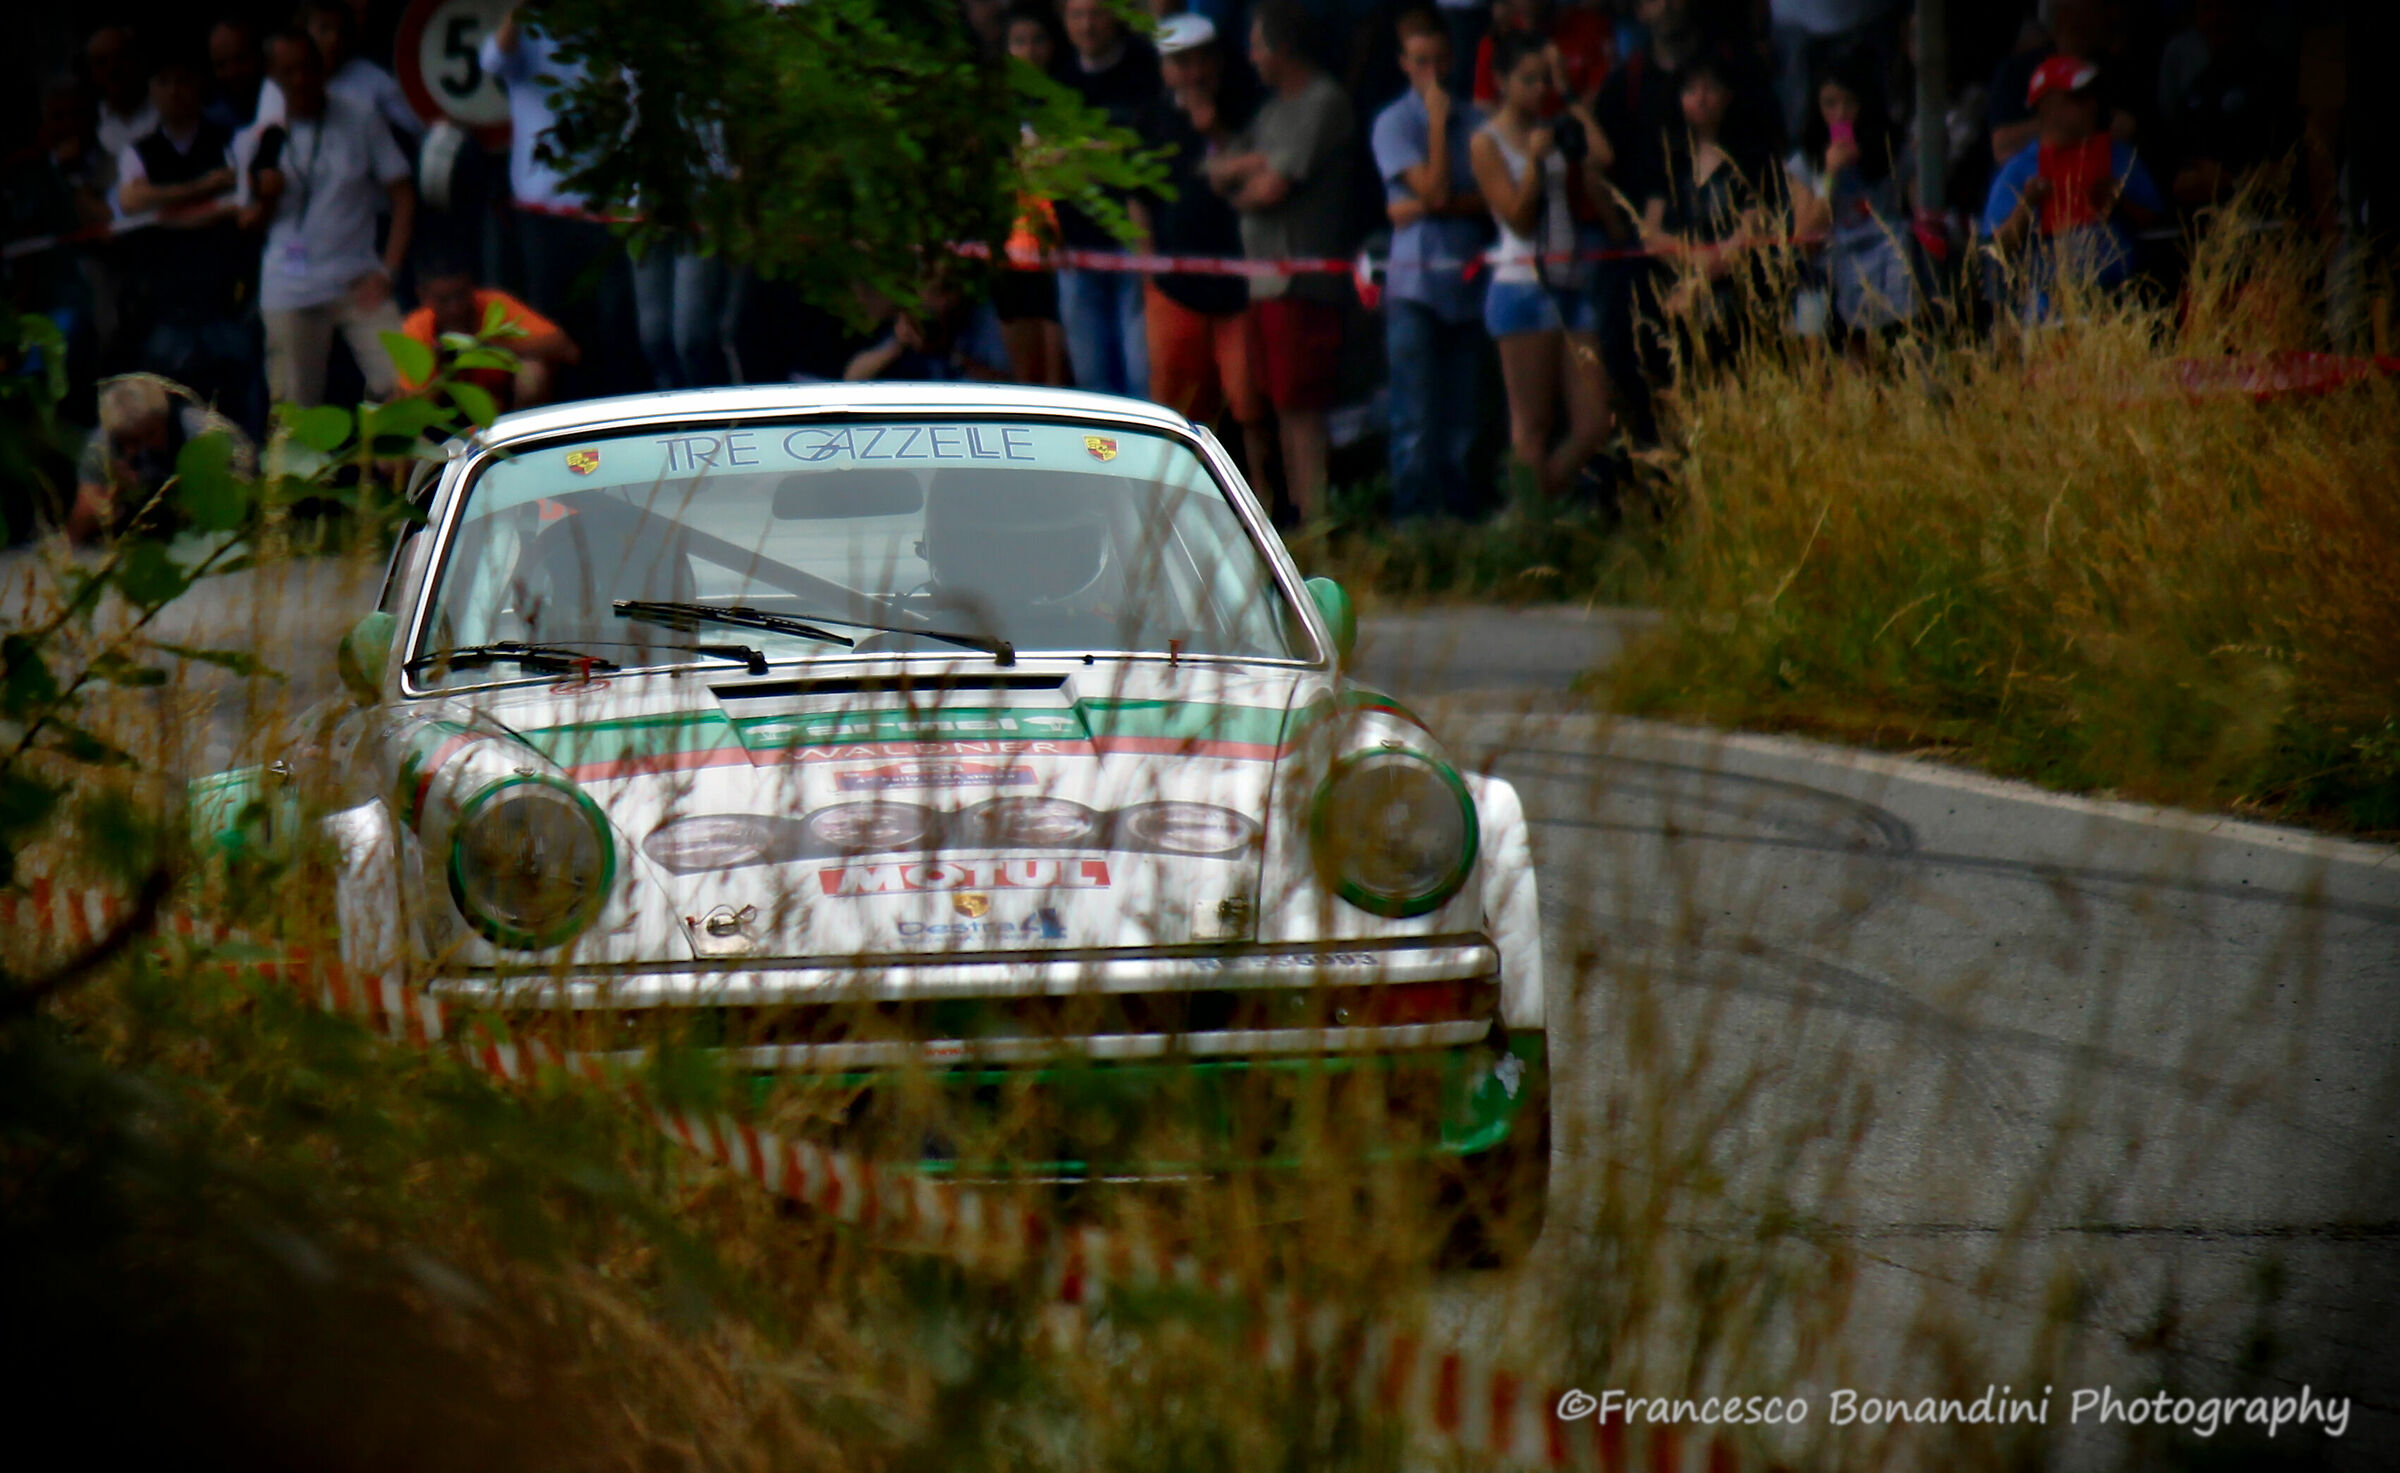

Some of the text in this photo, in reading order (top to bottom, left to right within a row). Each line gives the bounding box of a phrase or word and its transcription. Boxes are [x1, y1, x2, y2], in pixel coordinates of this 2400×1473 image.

[440, 17, 509, 98] 5
[656, 426, 1036, 472] TRE GAZZELLE
[791, 741, 1060, 760] WALDNER
[836, 860, 1100, 892] MOTUL
